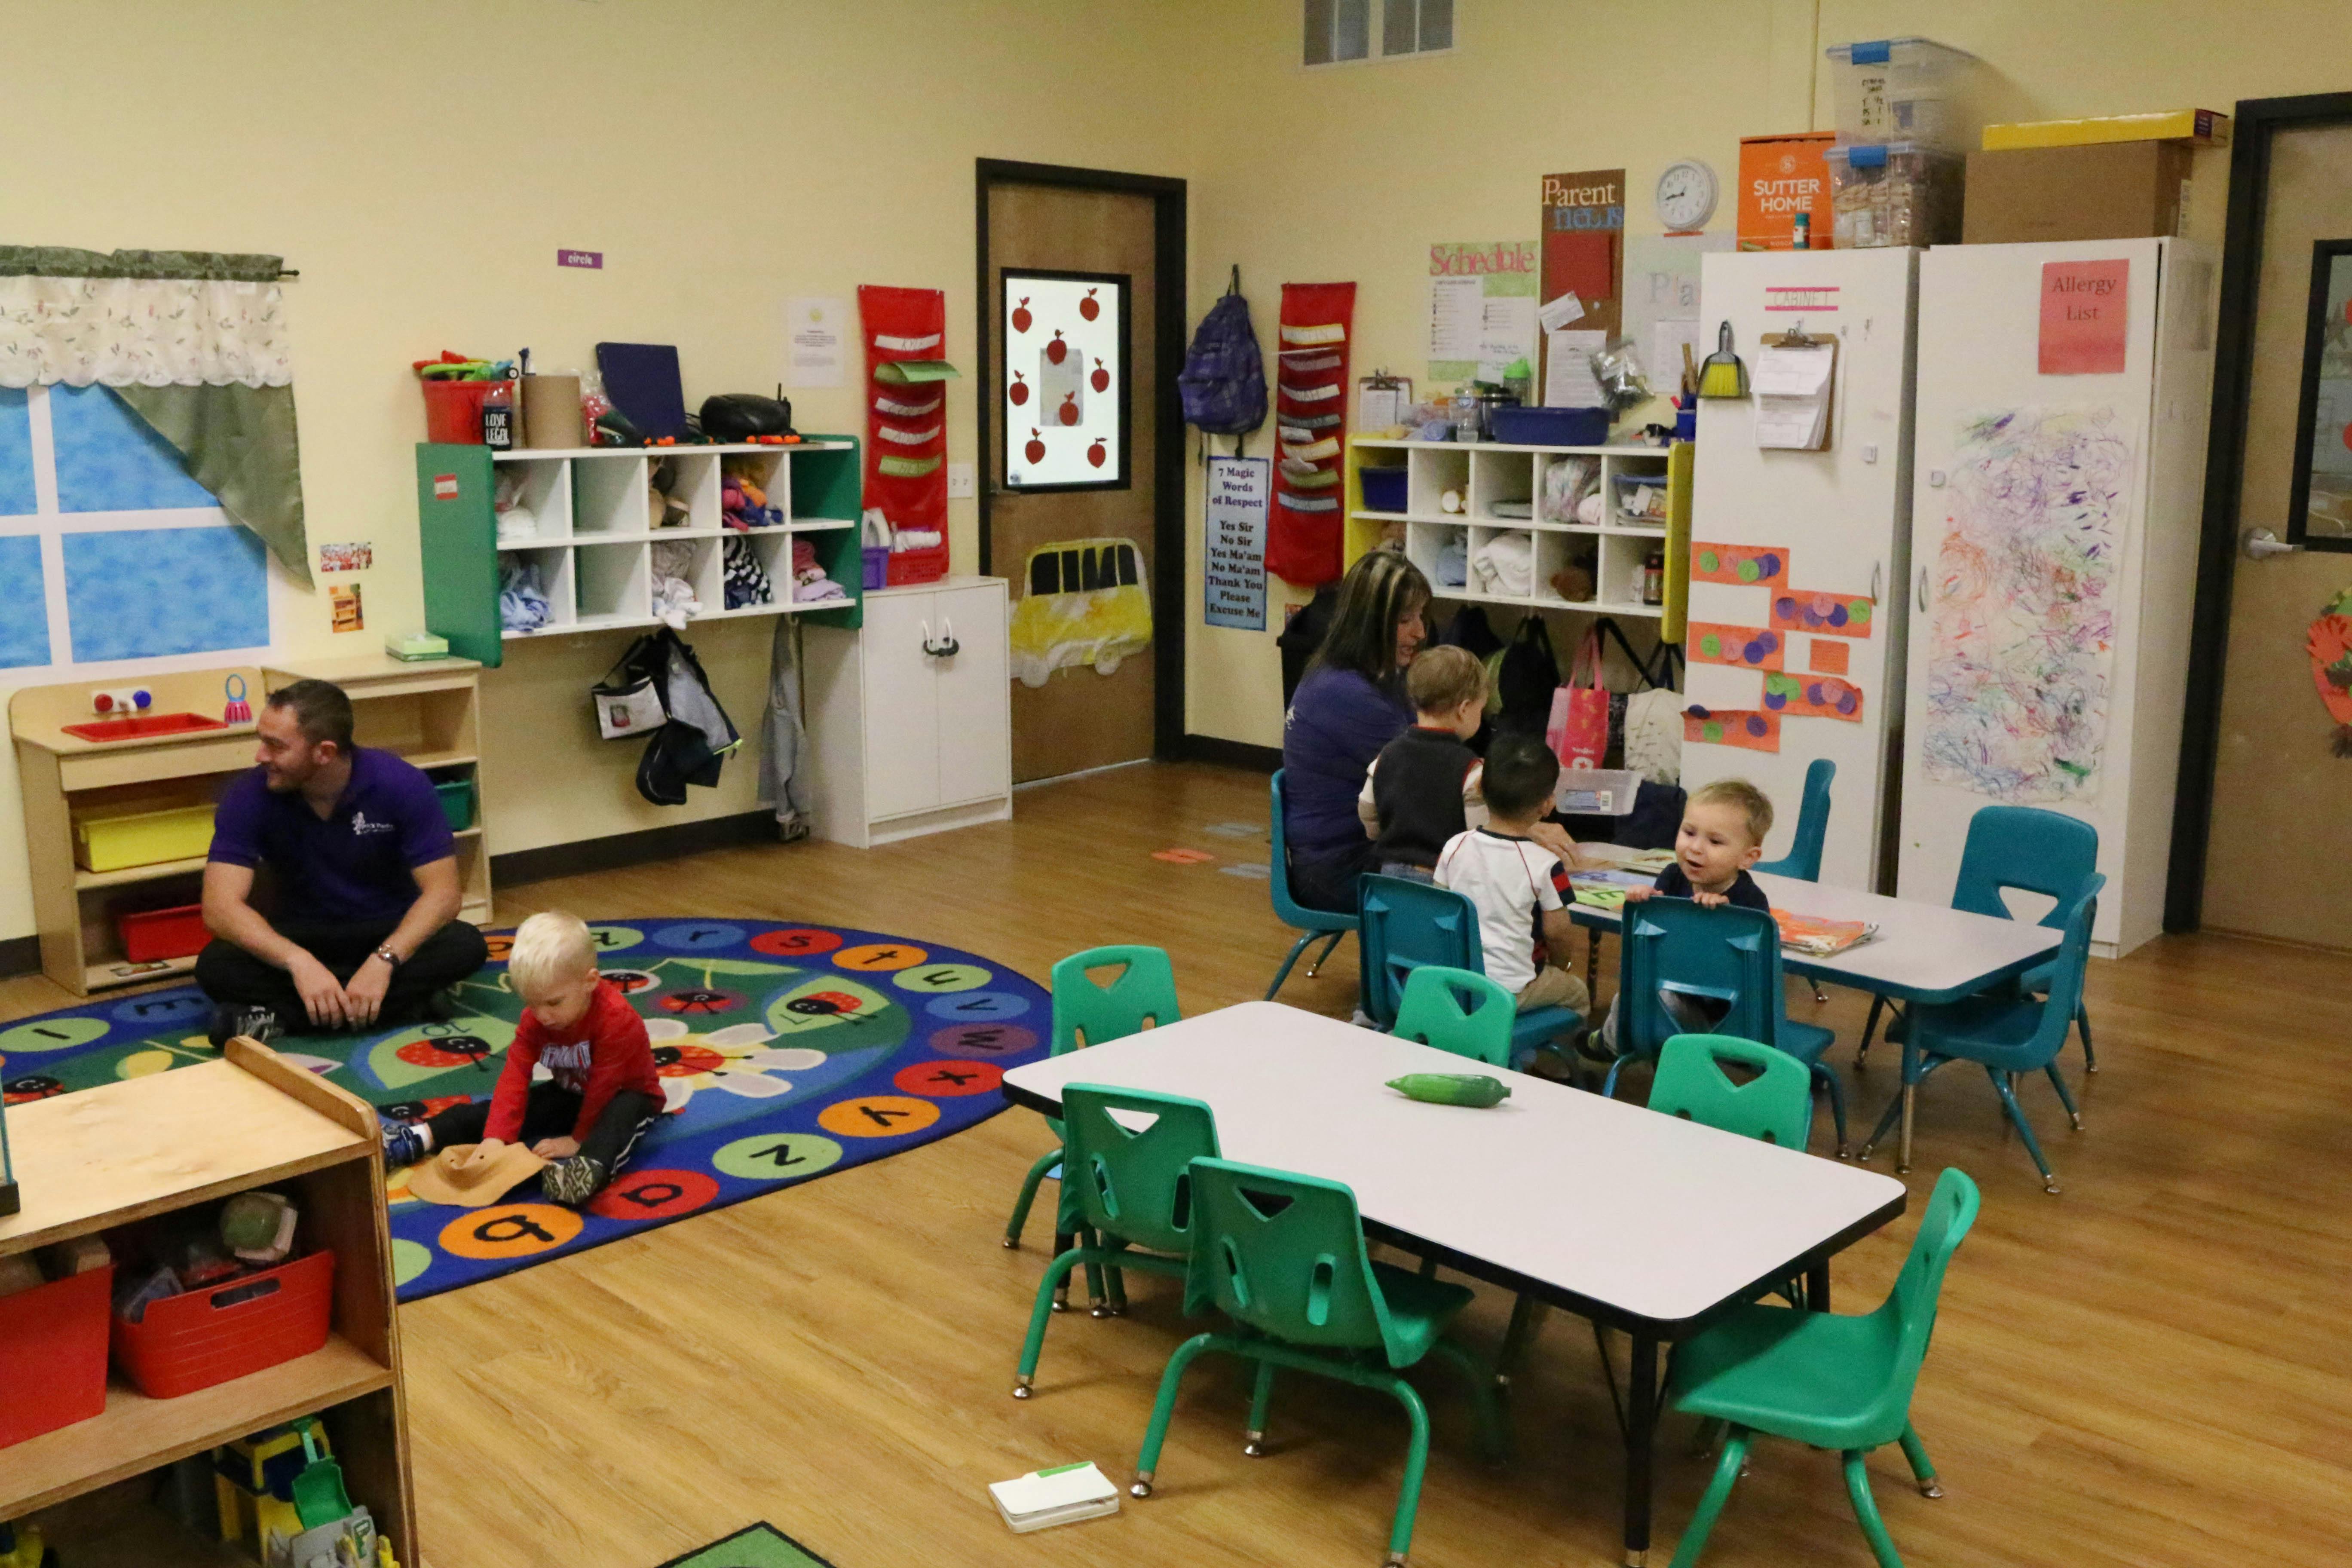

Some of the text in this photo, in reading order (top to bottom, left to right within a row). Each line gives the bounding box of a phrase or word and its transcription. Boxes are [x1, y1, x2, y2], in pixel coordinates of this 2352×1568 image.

[1542, 179, 1616, 207] Parent
[1753, 178, 1820, 196] SUTTER
[1761, 196, 1813, 211] HOME
[568, 252, 592, 265] circle
[1429, 242, 1535, 276] Schedule
[1649, 273, 1701, 306] Pla
[2052, 276, 2116, 295] Allergy
[1774, 291, 1829, 306] CABINET
[2067, 306, 2098, 320] List
[485, 413, 506, 427] LOVE
[1218, 467, 1255, 479] 7 Magic
[1222, 481, 1253, 492] Words
[1212, 495, 1263, 509] of Respect
[1220, 521, 1254, 533] Yes Sir
[1220, 535, 1252, 547] No Sir
[1211, 548, 1262, 562] Yes Ma'am
[1212, 562, 1260, 576] No Ma'am
[1208, 576, 1263, 591] Thank You
[1220, 590, 1251, 603] Please
[1210, 603, 1260, 618] Excuse Me
[779, 935, 812, 948] s
[862, 950, 898, 965] t
[922, 969, 962, 986] u
[955, 998, 998, 1011] v
[926, 1070, 979, 1086] x
[859, 1106, 911, 1127] y
[619, 1183, 683, 1207] a
